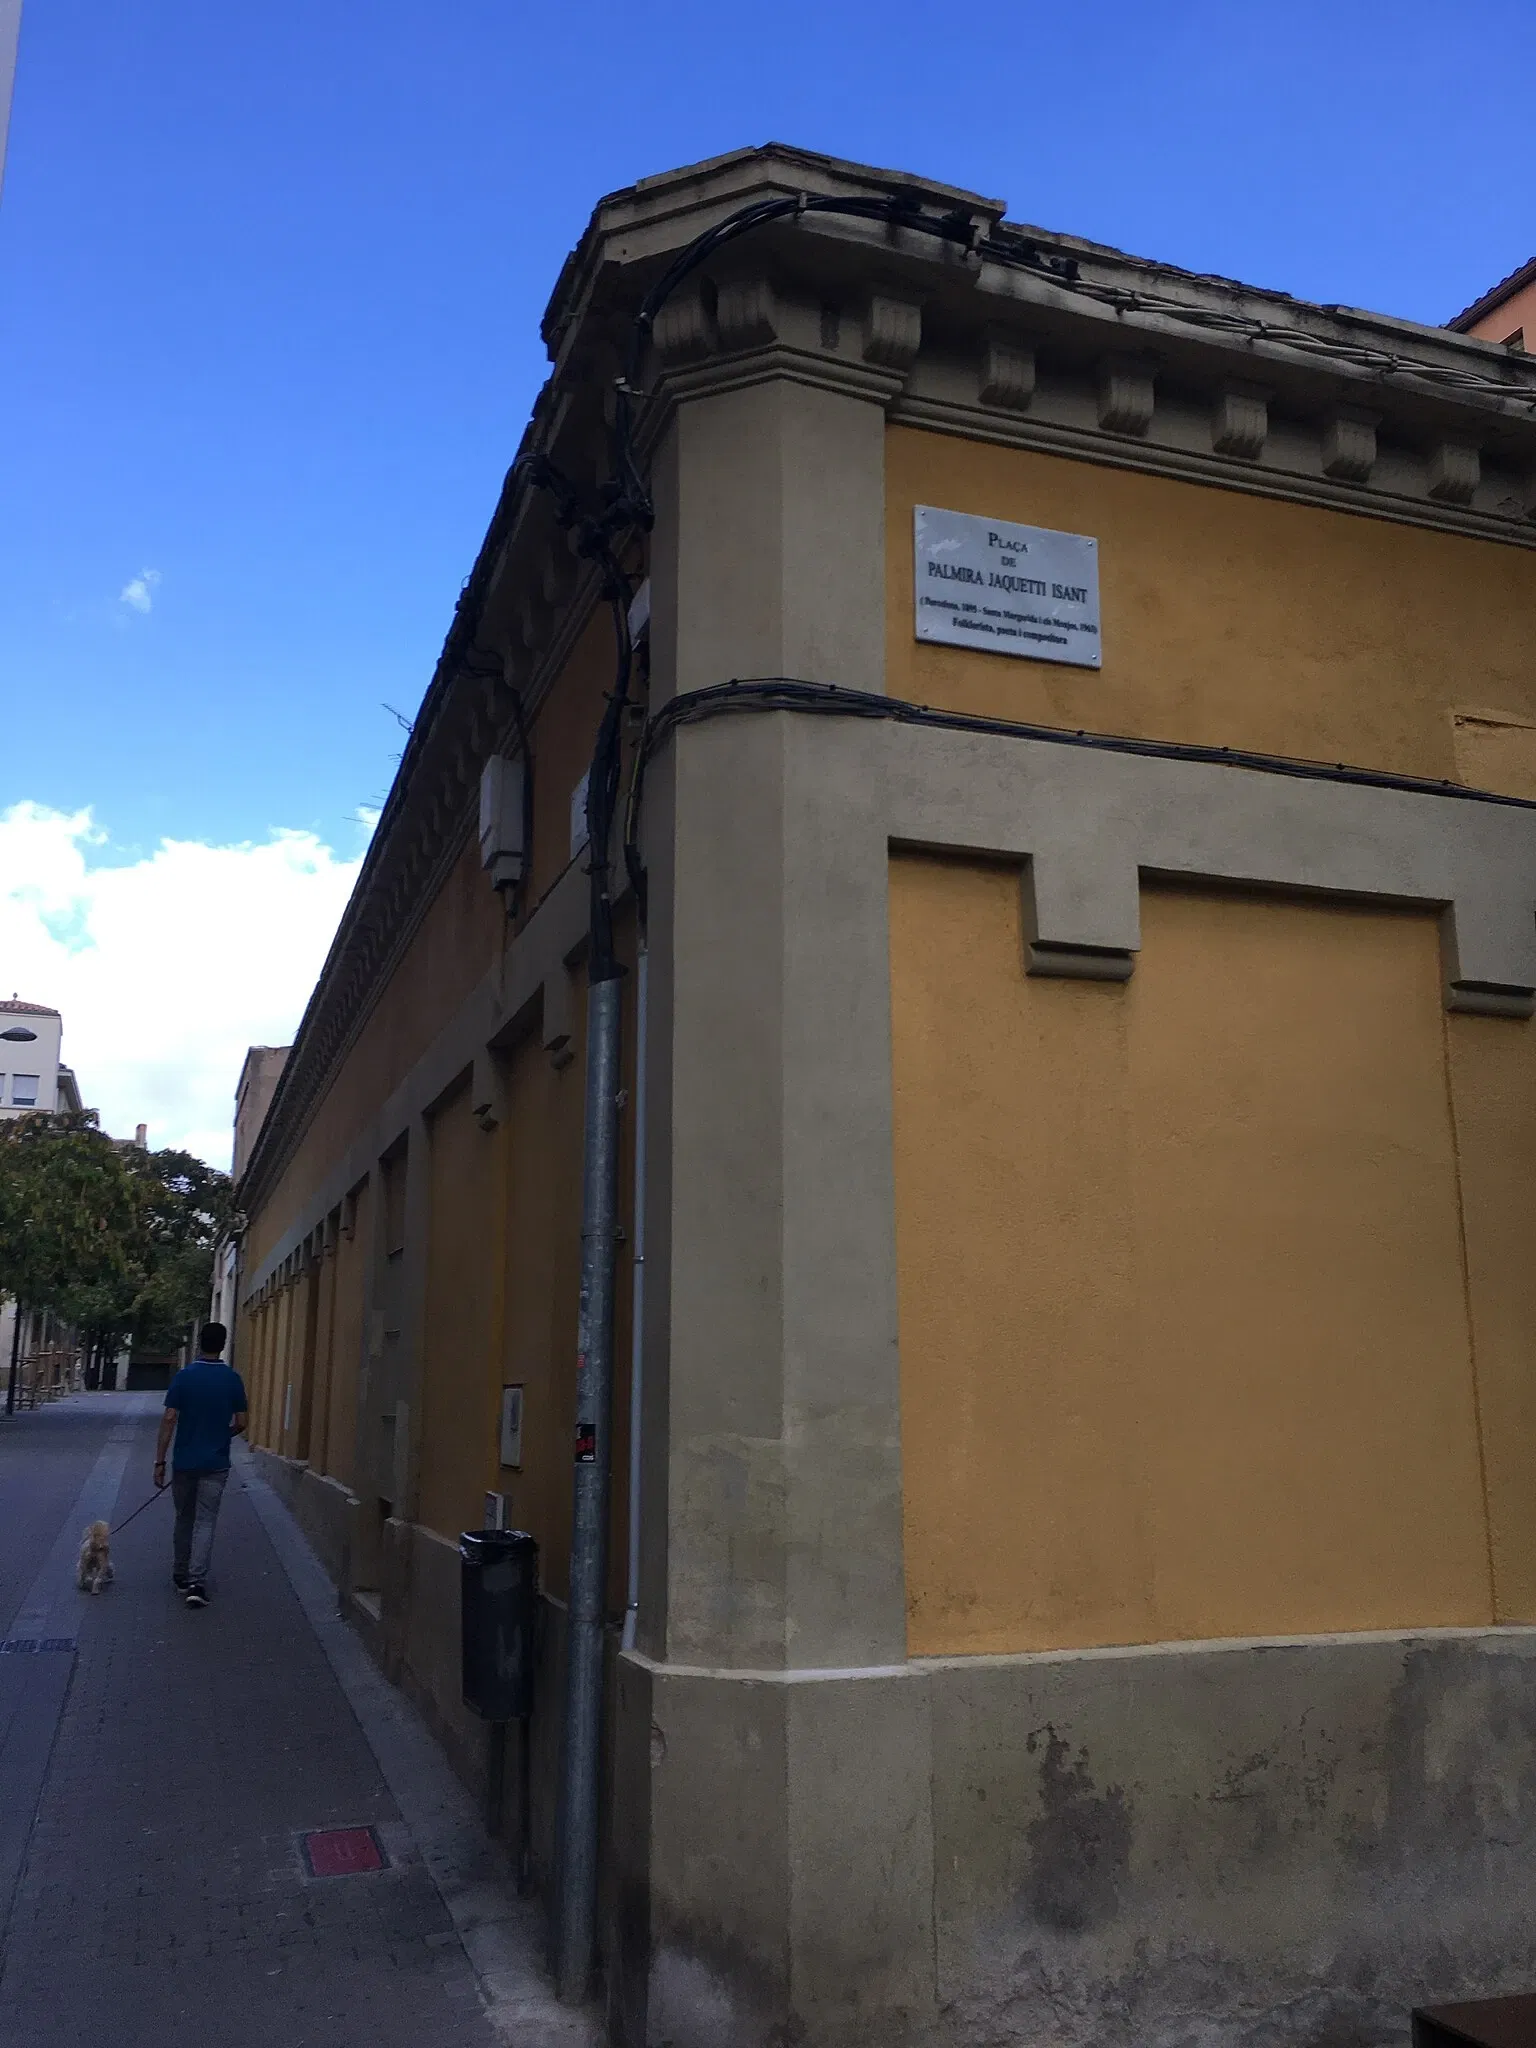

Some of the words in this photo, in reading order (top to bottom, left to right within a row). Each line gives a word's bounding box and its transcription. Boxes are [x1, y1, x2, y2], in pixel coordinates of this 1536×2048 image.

[988, 532, 1028, 553] PLAÇA
[1001, 556, 1017, 567] DE
[928, 562, 984, 586] PALMIRA
[988, 572, 1046, 597] JAQUETTI
[1052, 583, 1088, 604] ISANT
